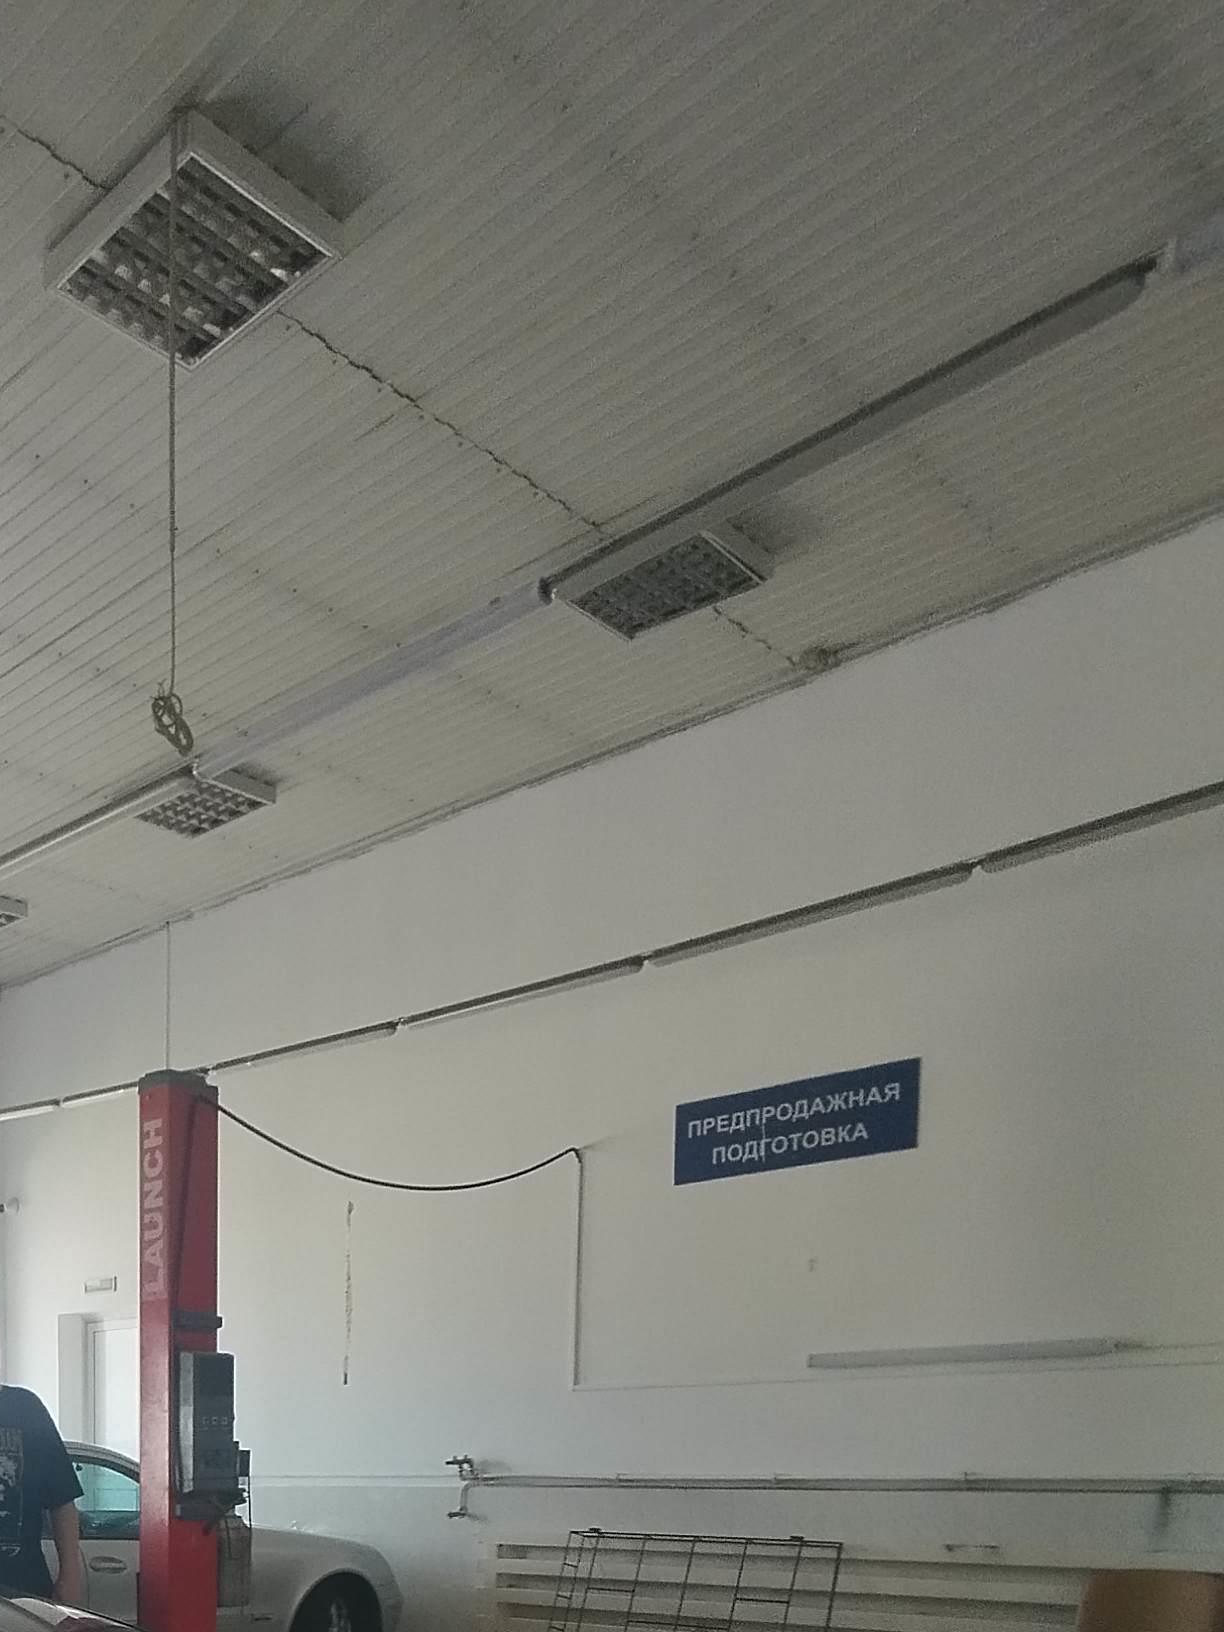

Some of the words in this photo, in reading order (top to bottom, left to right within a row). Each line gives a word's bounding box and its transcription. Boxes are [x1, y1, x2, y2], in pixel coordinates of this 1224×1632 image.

[687, 1083, 901, 1139] ПРЕДПРОДАЖНАЯ
[712, 1122, 869, 1165] ПОДГОТОВКА
[142, 1117, 165, 1299] LAUNCH
